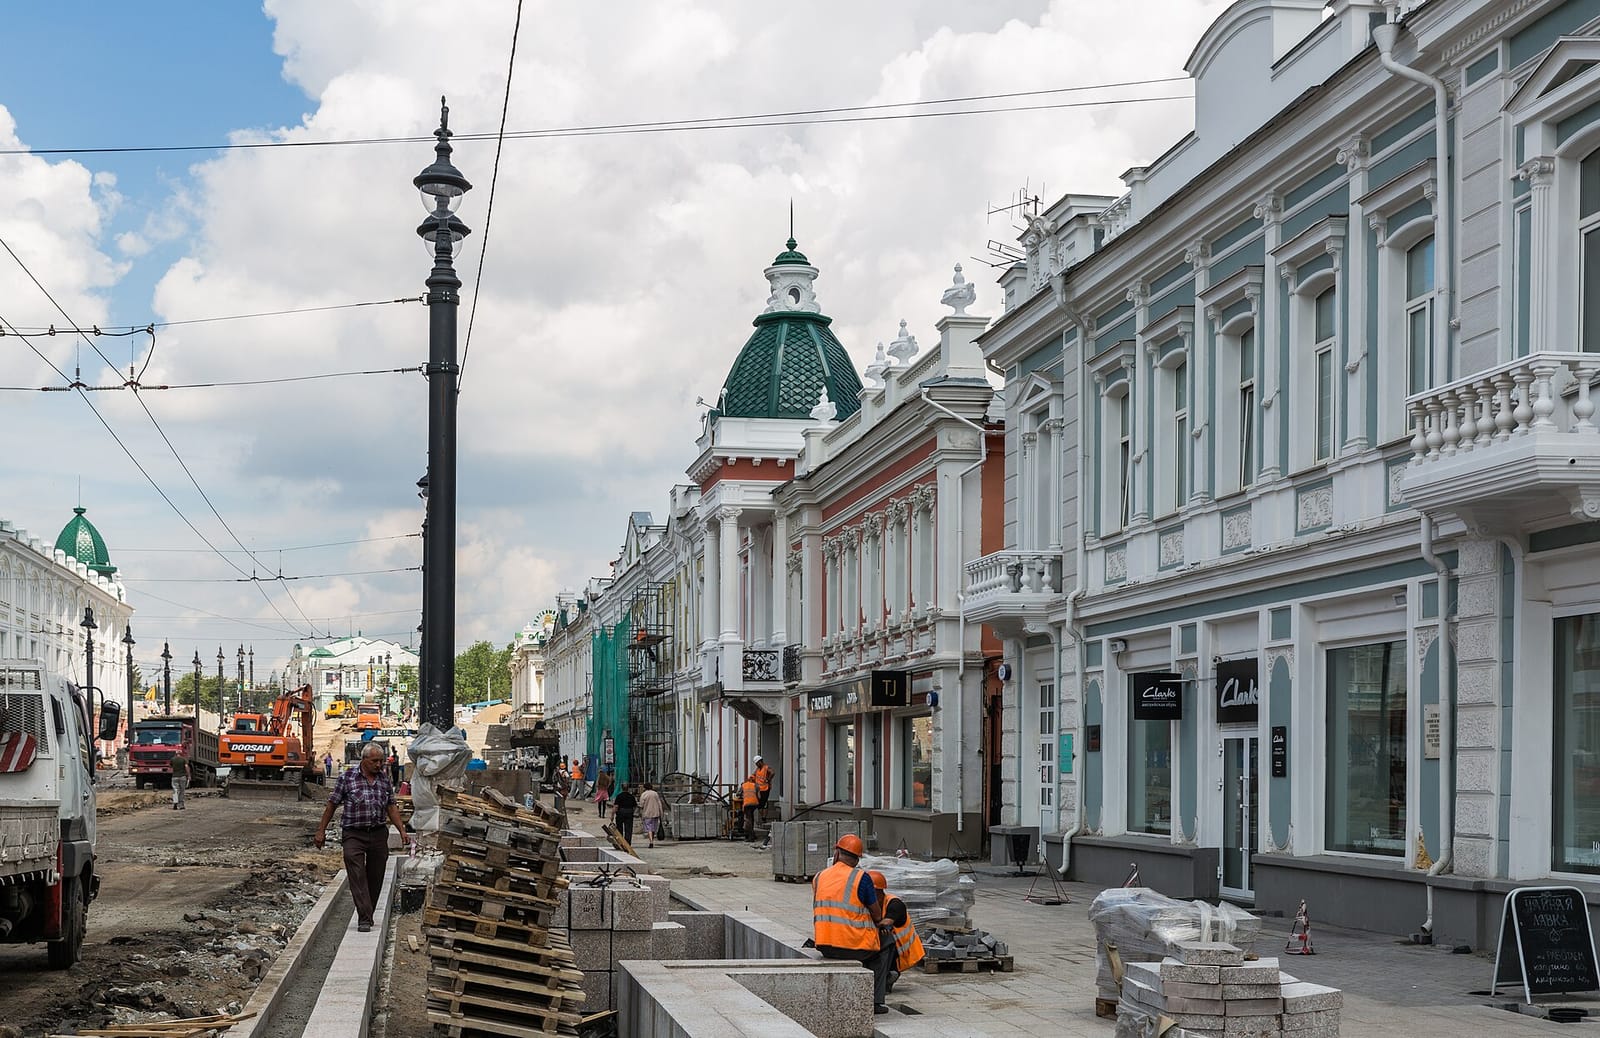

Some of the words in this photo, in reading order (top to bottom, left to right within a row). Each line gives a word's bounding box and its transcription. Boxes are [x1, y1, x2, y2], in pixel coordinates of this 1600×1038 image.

[882, 680, 896, 697] TJ
[1142, 686, 1176, 698] Clarks
[231, 744, 272, 752] DOOSAN
[1533, 913, 1569, 927] ЛАВКА
